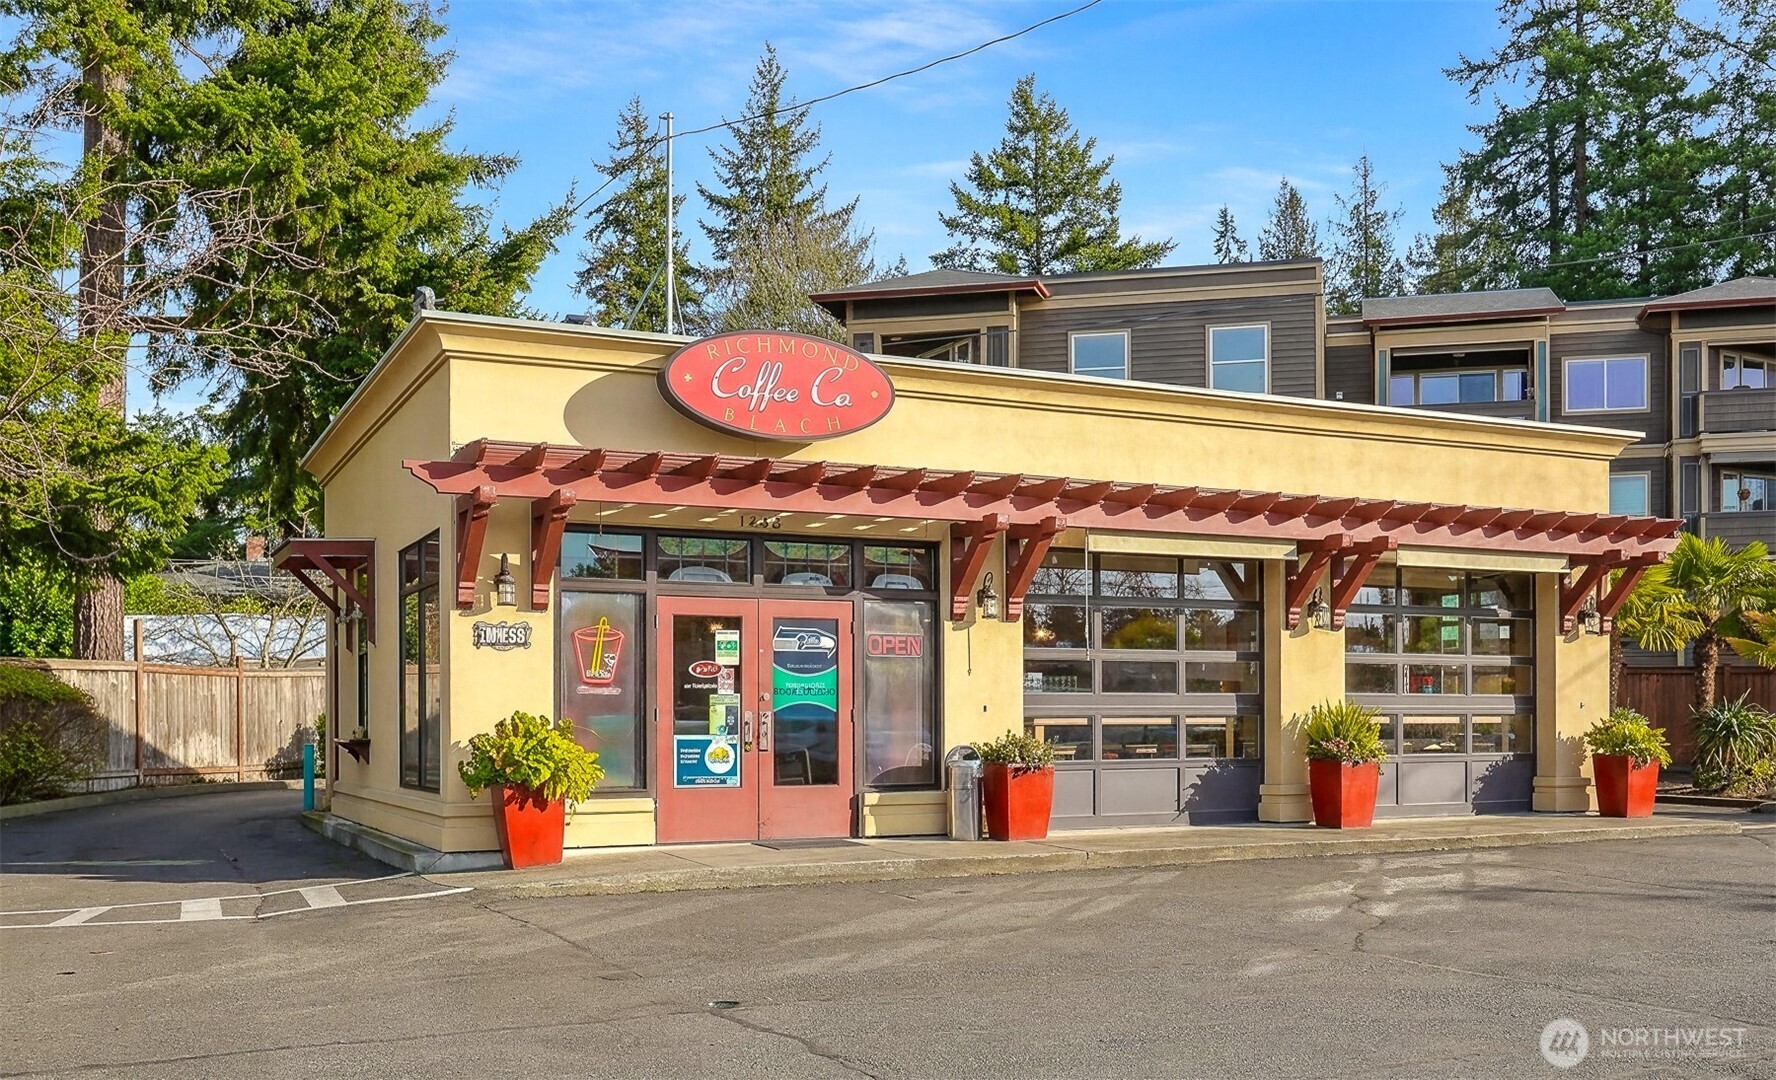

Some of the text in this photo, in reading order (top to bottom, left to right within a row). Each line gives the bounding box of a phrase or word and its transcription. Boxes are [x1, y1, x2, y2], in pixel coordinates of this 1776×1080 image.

[705, 337, 859, 371] RICHMOND
[711, 356, 799, 412] Coffee
[868, 635, 921, 655] OPEN
